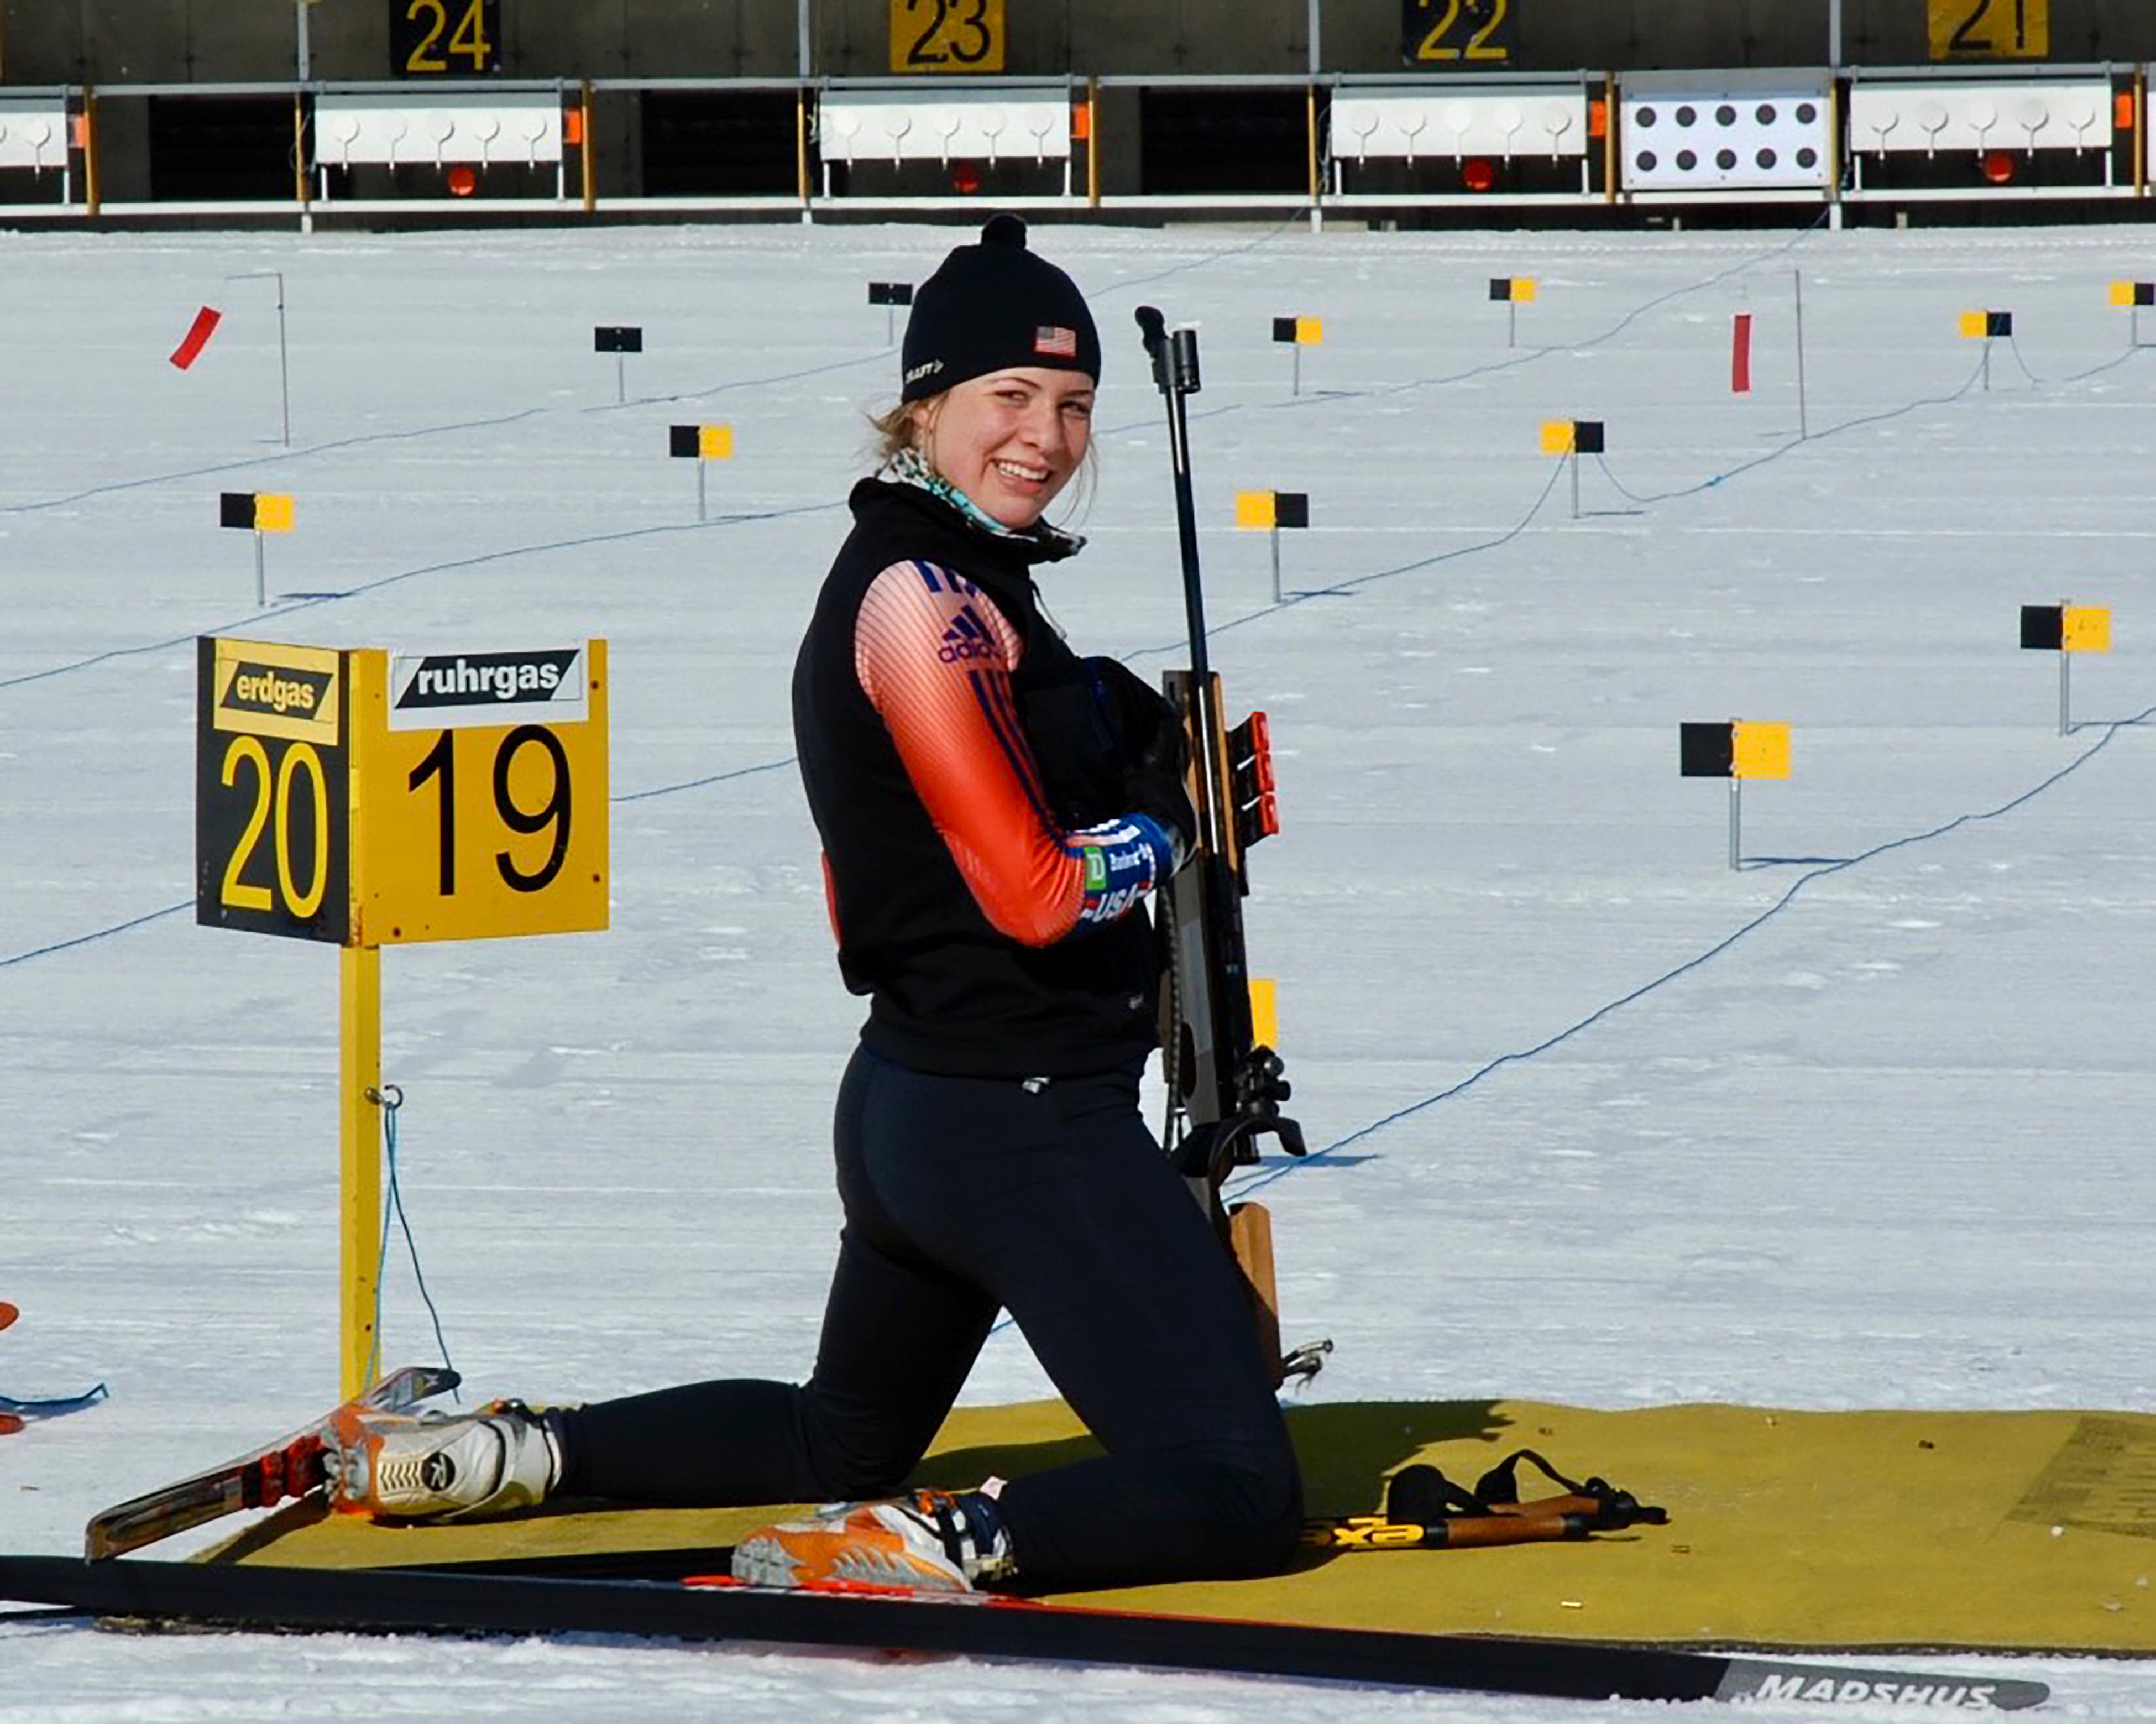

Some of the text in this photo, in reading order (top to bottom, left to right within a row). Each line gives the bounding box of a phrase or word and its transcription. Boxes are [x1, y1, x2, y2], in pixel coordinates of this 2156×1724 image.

[406, 0, 491, 71] 24
[907, 0, 990, 64] 23
[1417, 0, 1506, 59] 22
[1949, 0, 2024, 50] 21
[236, 671, 314, 712] erdgas
[417, 660, 559, 699] ruhrgas
[221, 735, 328, 918] 20
[408, 724, 572, 896] 19
[1092, 882, 1139, 922] USA
[1756, 1674, 1996, 1708] MADSHUS
